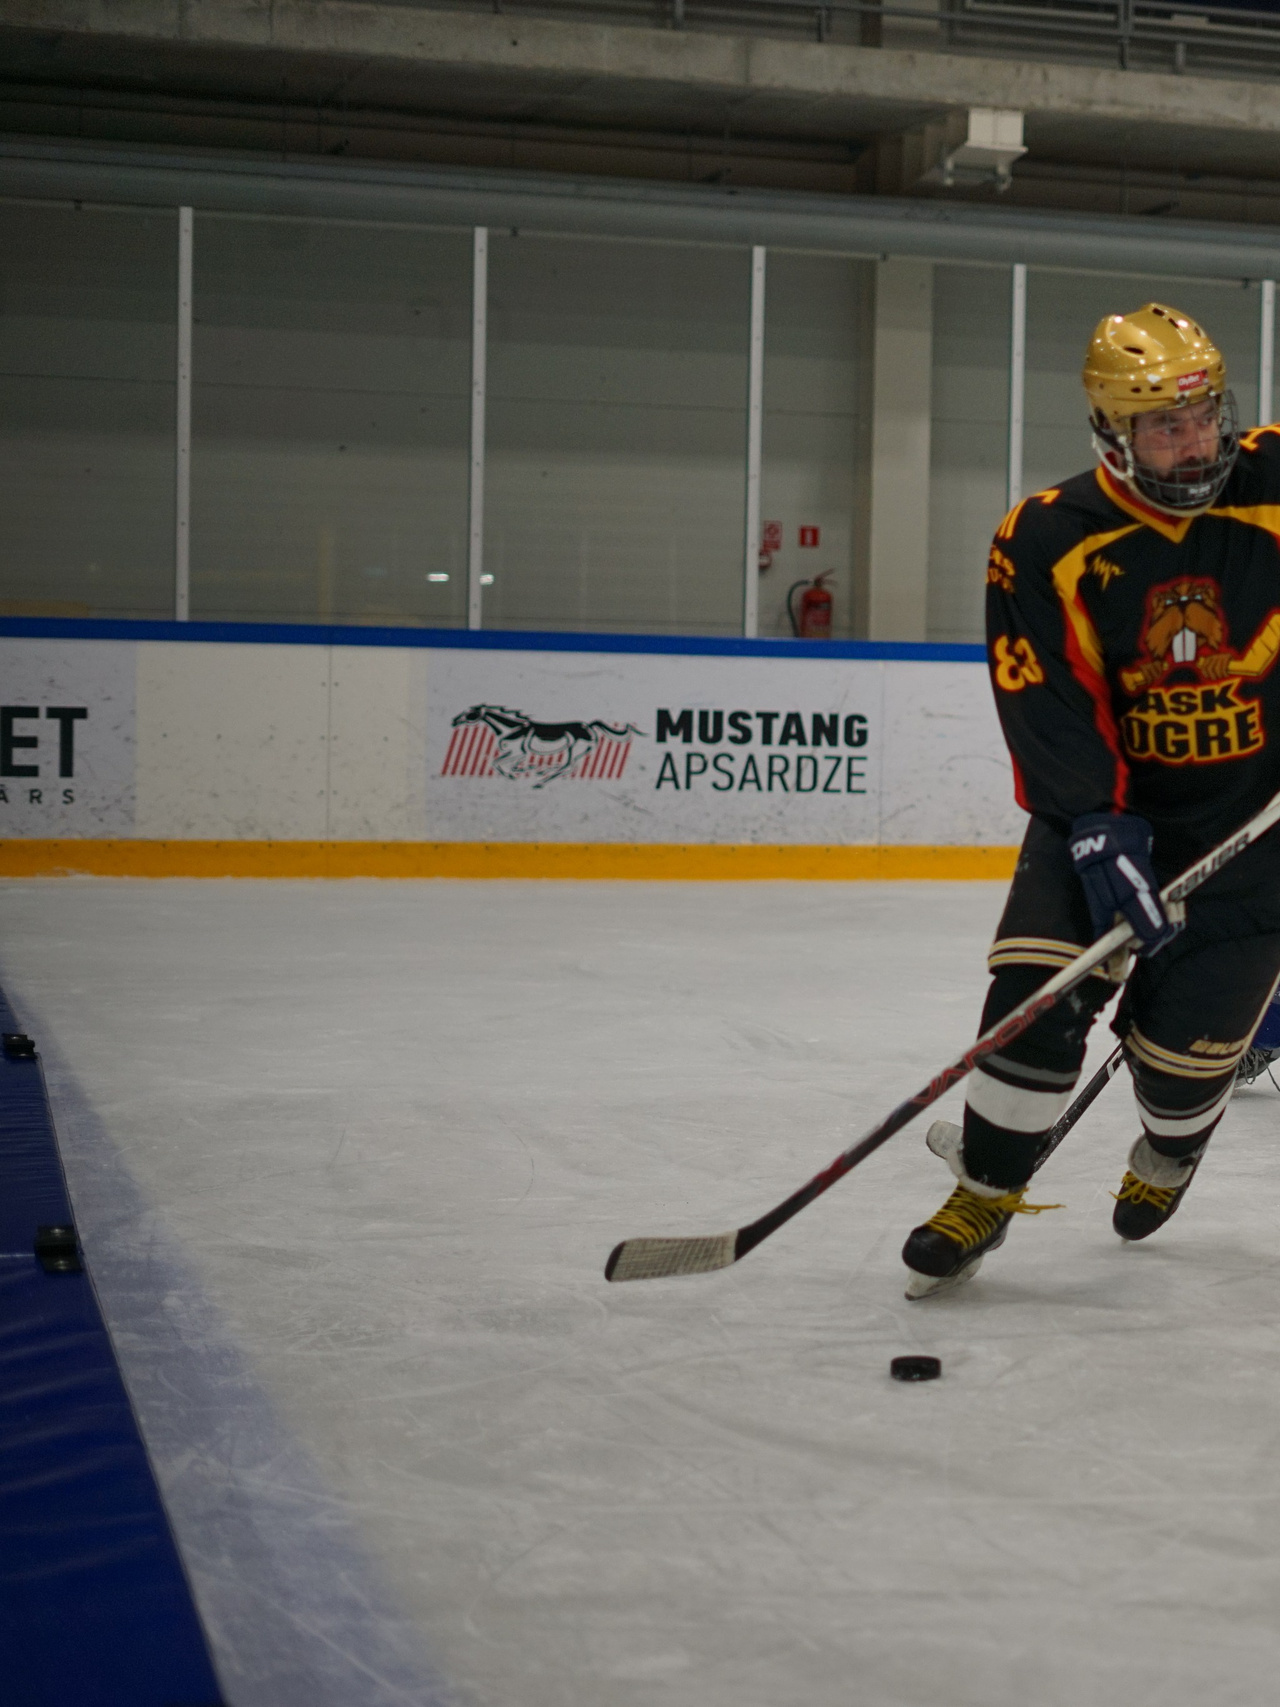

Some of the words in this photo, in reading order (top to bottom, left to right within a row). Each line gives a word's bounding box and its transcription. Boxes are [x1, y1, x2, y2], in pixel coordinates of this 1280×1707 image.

[1136, 682, 1238, 716] ASK
[0, 706, 88, 778] ET
[656, 708, 869, 748] MUSTANG
[655, 751, 868, 794] APSARDZE
